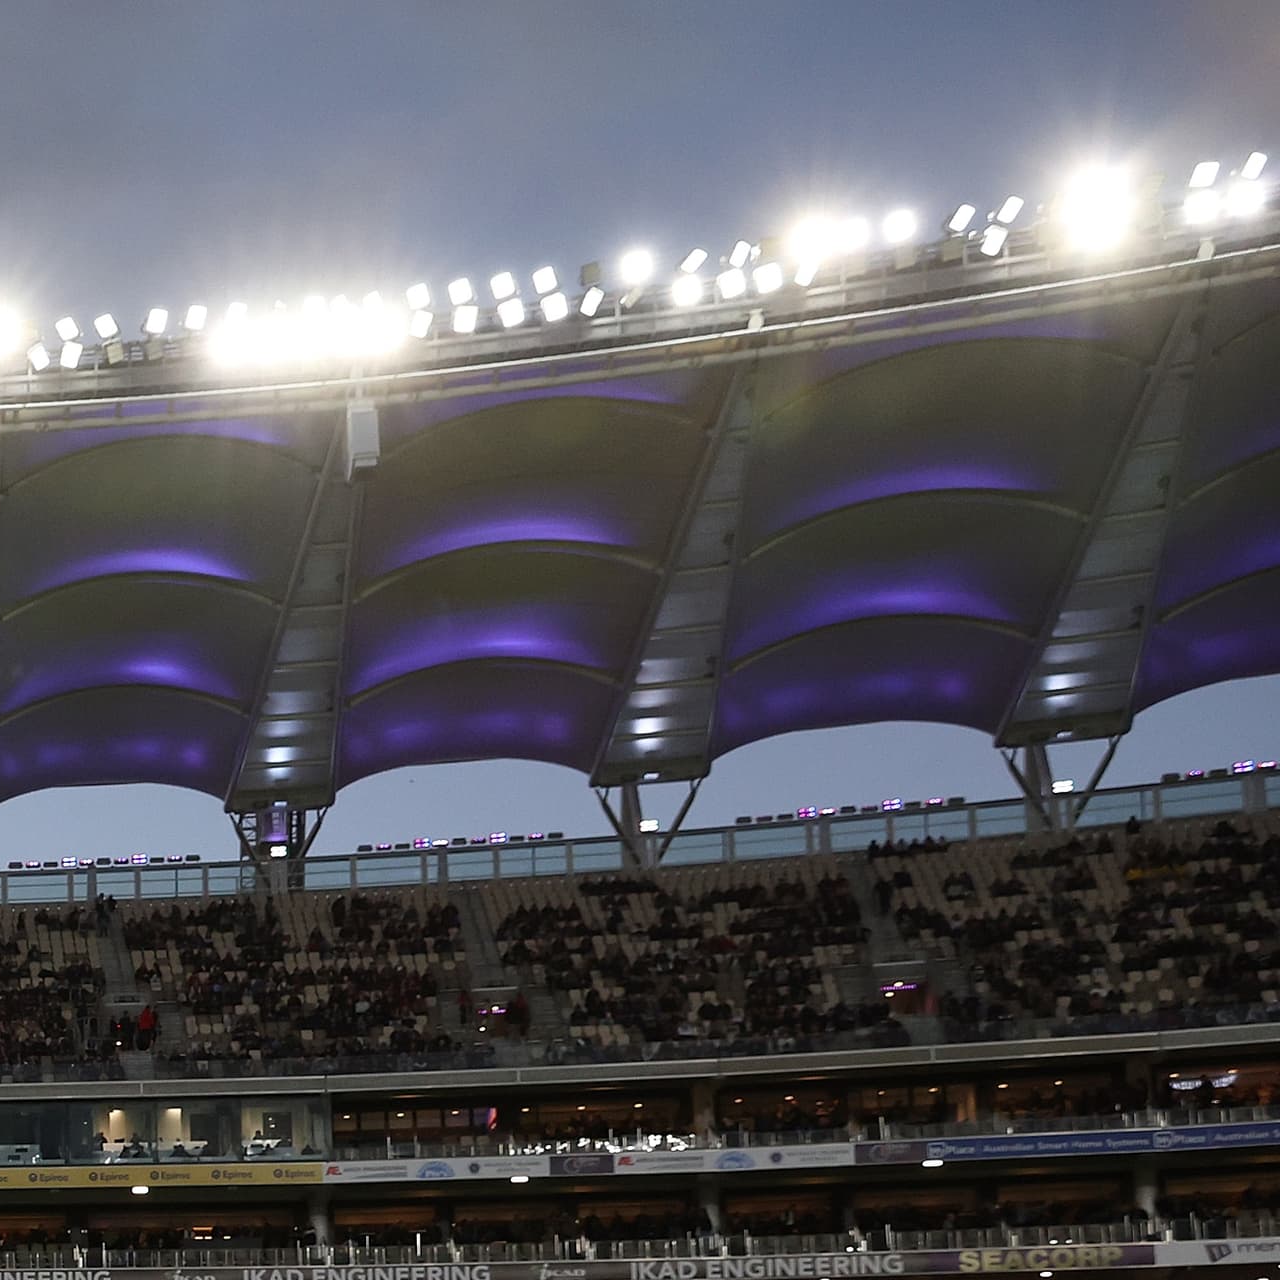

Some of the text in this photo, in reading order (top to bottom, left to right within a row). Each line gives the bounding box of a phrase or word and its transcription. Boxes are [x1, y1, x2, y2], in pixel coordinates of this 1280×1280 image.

[630, 1255, 905, 1280] IKAD ENGINEERING
[958, 1247, 1124, 1273] SEACORP
